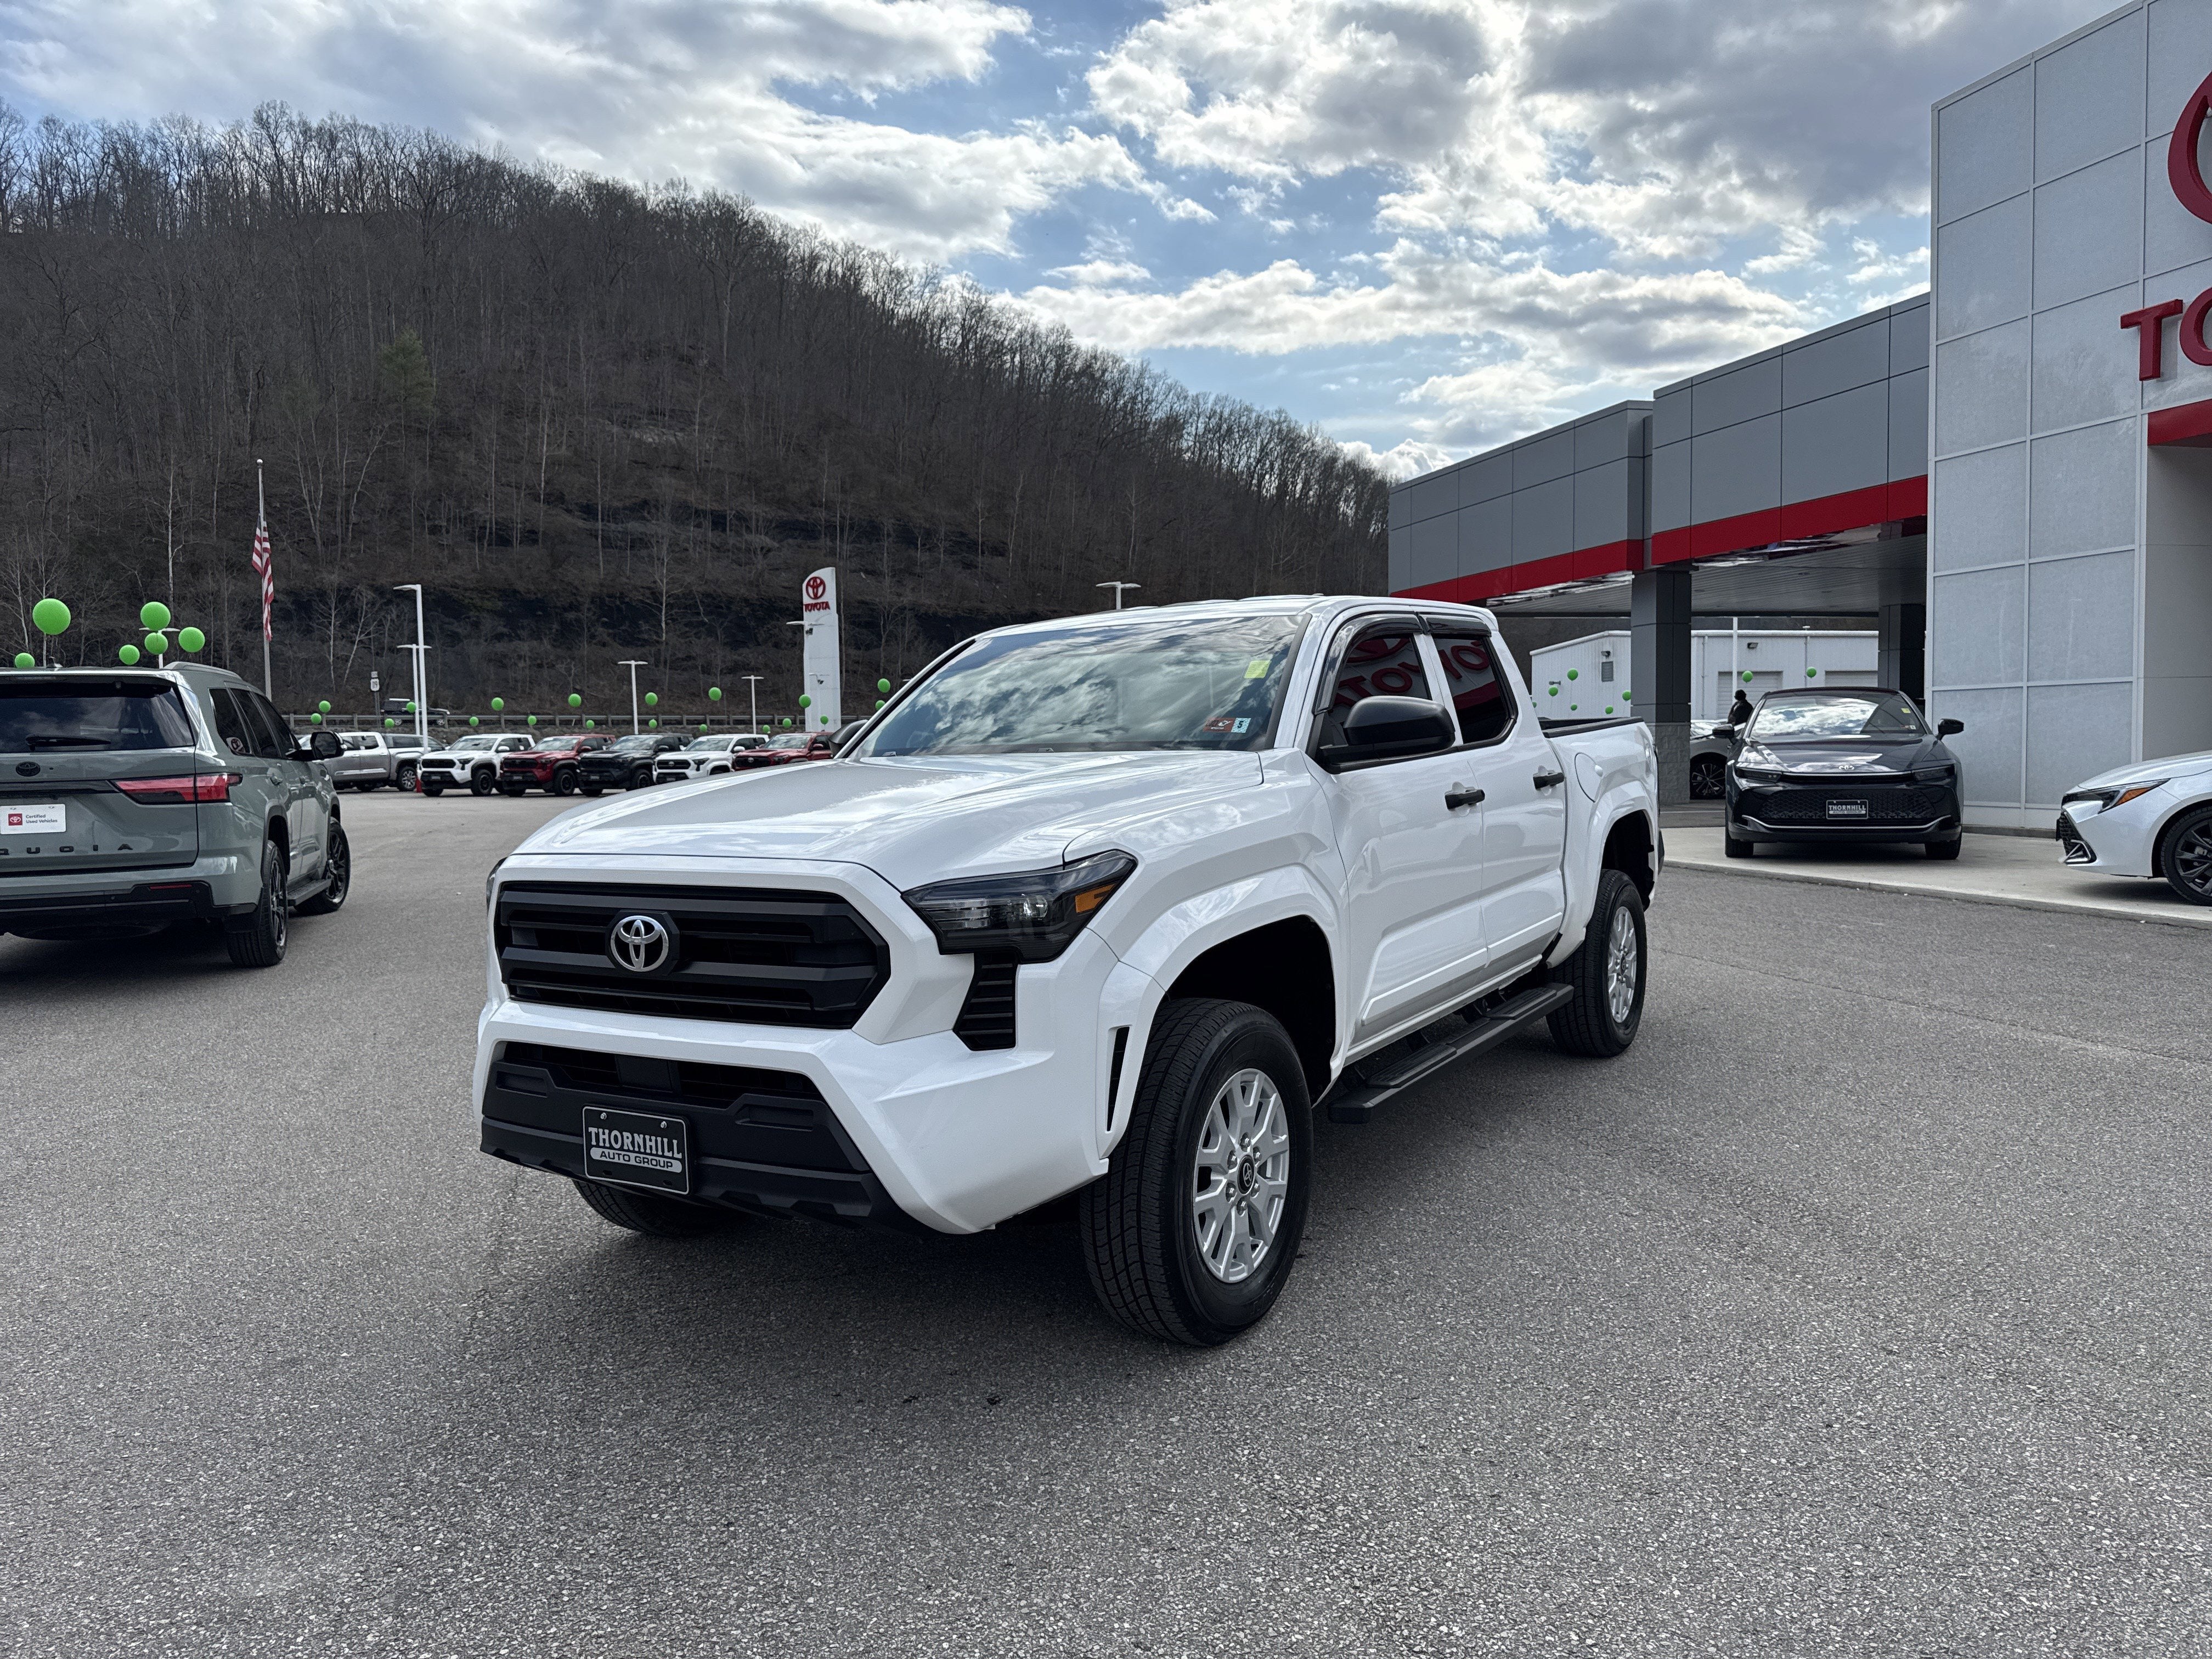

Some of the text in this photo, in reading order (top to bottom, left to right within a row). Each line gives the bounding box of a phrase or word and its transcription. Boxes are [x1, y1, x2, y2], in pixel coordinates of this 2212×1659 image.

[804, 601, 830, 612] TOYOTA
[1237, 720, 1244, 729] 5
[588, 1127, 682, 1159] THORNHILL
[600, 1150, 673, 1169] AUTO GROUP
